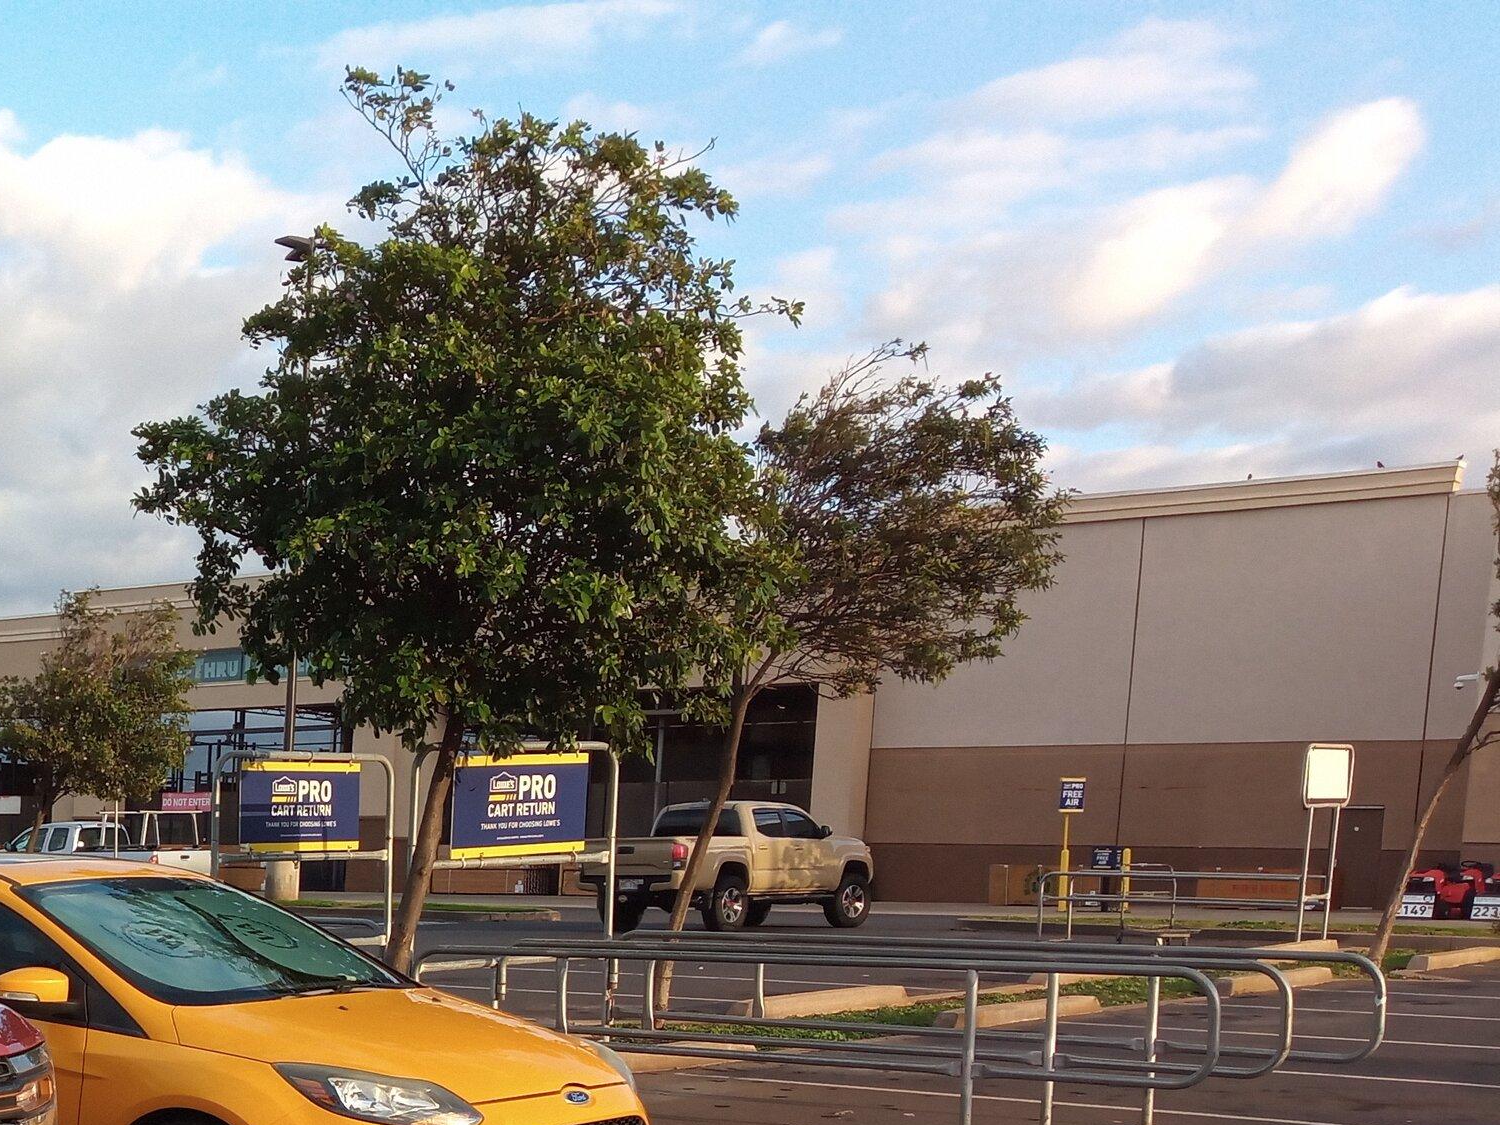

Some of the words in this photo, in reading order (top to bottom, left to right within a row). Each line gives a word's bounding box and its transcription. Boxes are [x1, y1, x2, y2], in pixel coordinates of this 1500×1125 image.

[298, 779, 332, 803] PRO
[518, 773, 557, 800] PRO
[1062, 790, 1084, 798] FREE
[162, 798, 172, 806] DO
[173, 798, 187, 806] NOT
[188, 797, 211, 806] ENTER
[1065, 798, 1079, 806] AIR
[271, 804, 295, 817] CART
[296, 804, 332, 817] RETURN
[488, 803, 514, 818] CART
[516, 801, 556, 816] RETURN
[508, 821, 518, 829] FOR
[519, 820, 543, 828] CHOOSING
[543, 819, 561, 827] LOWE'S
[1396, 905, 1427, 916] 149
